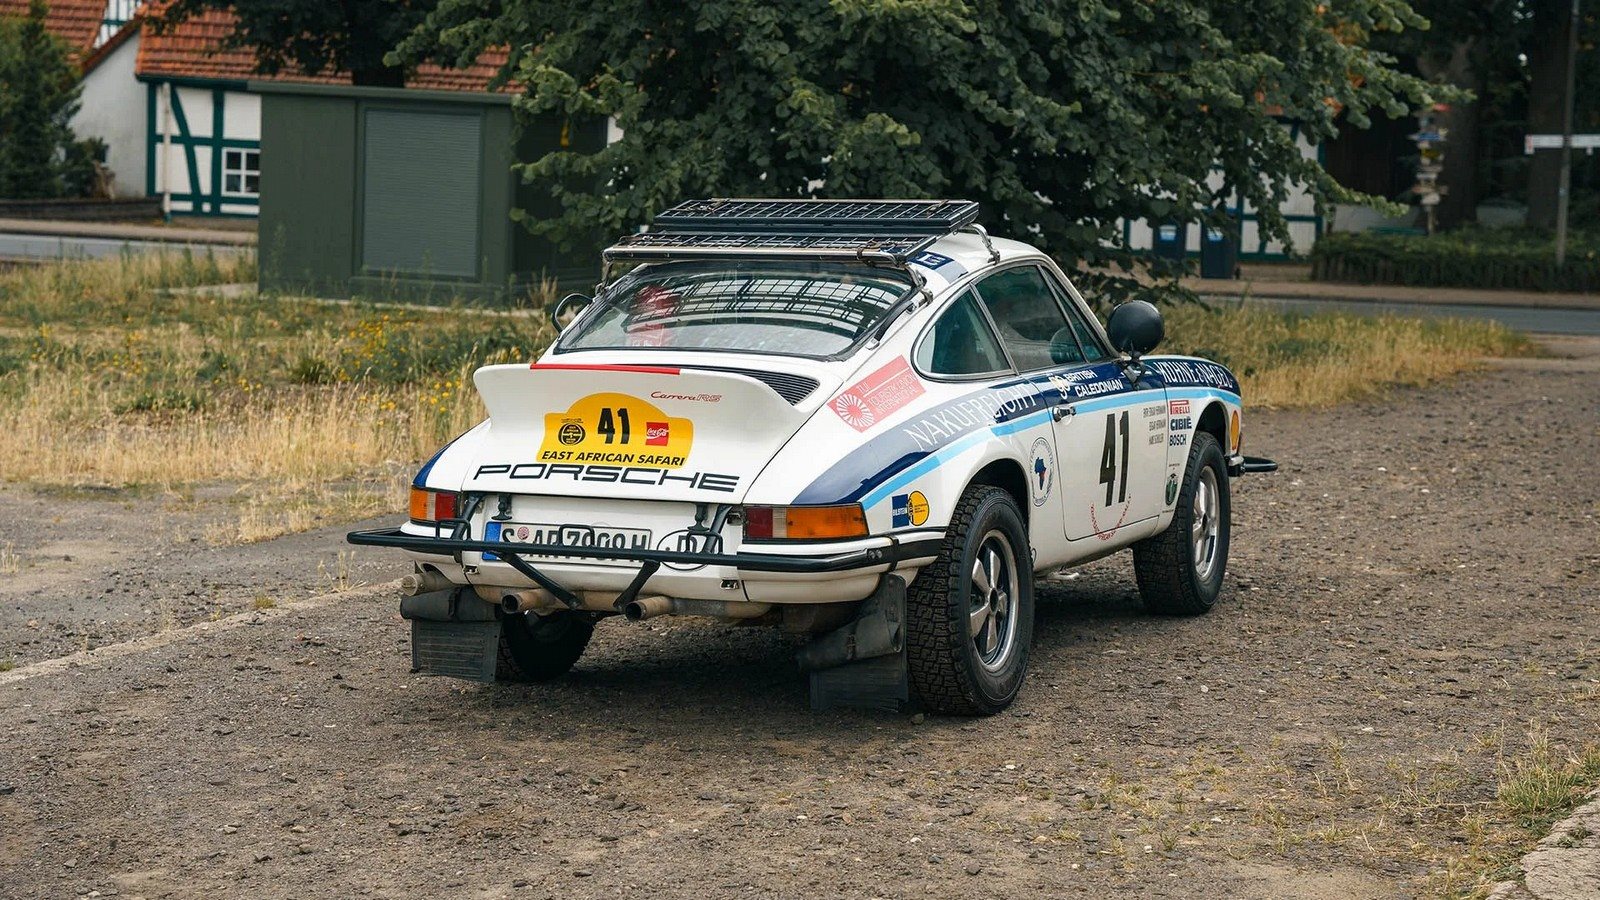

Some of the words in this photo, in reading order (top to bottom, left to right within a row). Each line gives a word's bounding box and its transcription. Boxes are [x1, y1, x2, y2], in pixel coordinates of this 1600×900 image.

[1063, 369, 1098, 382] BRITISH
[1074, 379, 1124, 397] CALEDONIAN
[650, 391, 696, 401] Carrera
[1169, 400, 1191, 415] PIRELLI
[597, 408, 630, 444] 41
[1169, 434, 1187, 446] BOSCH
[541, 451, 574, 461] EAST
[575, 452, 635, 463] AFRICAN
[637, 455, 686, 466] SAFARI
[1099, 410, 1130, 508] 41
[473, 463, 741, 493] PORSCHE
